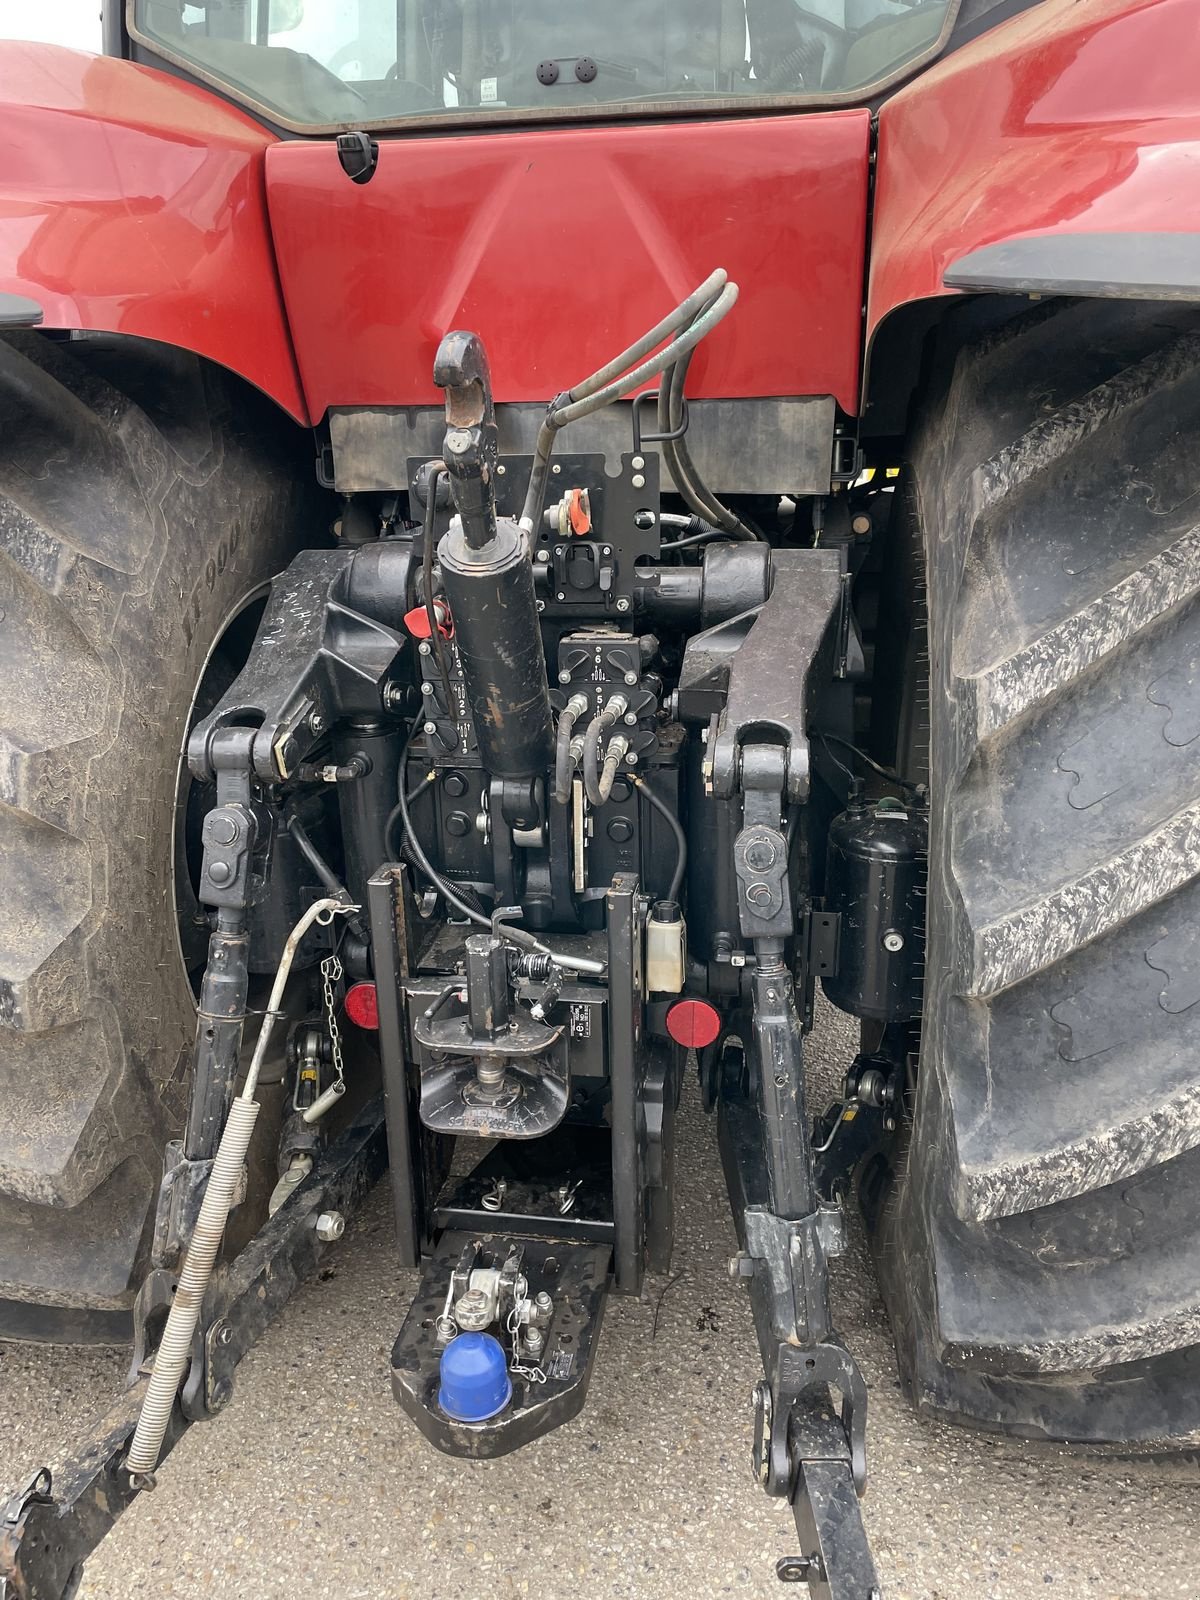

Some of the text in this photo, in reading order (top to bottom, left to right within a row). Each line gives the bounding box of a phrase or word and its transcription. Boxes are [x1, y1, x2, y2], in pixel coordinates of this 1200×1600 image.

[206, 518, 241, 593] 900
[456, 660, 462, 668] 3
[595, 655, 601, 664] 6
[459, 699, 465, 708] 2
[597, 695, 603, 704] 5
[462, 739, 467, 748] 1
[597, 735, 602, 744] 4
